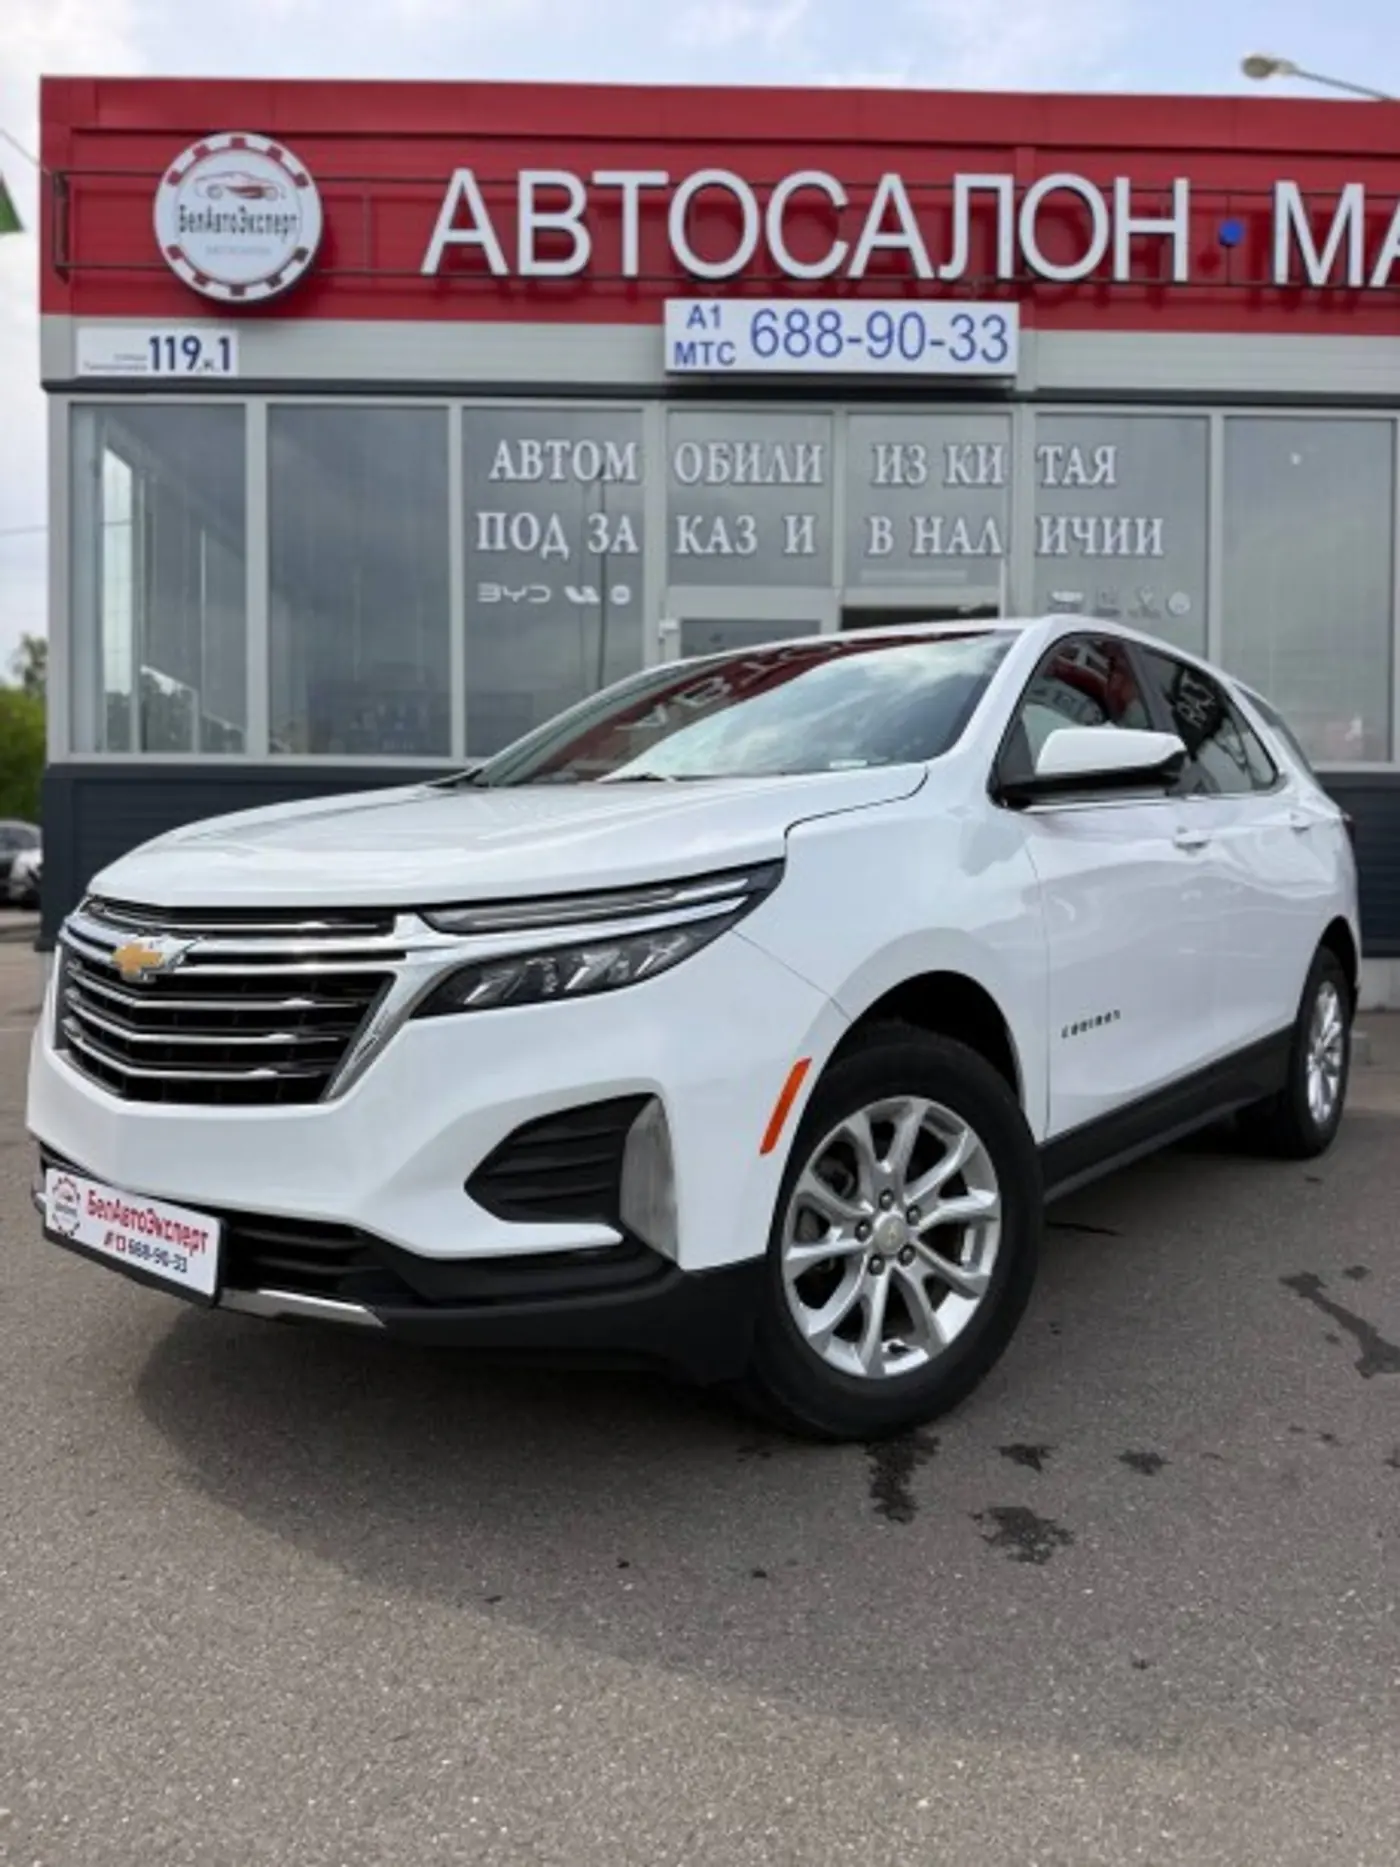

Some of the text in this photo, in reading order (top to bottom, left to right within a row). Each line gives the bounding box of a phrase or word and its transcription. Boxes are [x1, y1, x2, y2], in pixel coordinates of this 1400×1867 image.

[421, 168, 1189, 283] АВТОСАЛОН
[674, 341, 736, 366] МТС
[751, 308, 1009, 364] 688-90-33
[873, 444, 928, 485] ИЗ
[477, 512, 570, 560] ПОД
[784, 515, 815, 554] И
[868, 516, 894, 555] В
